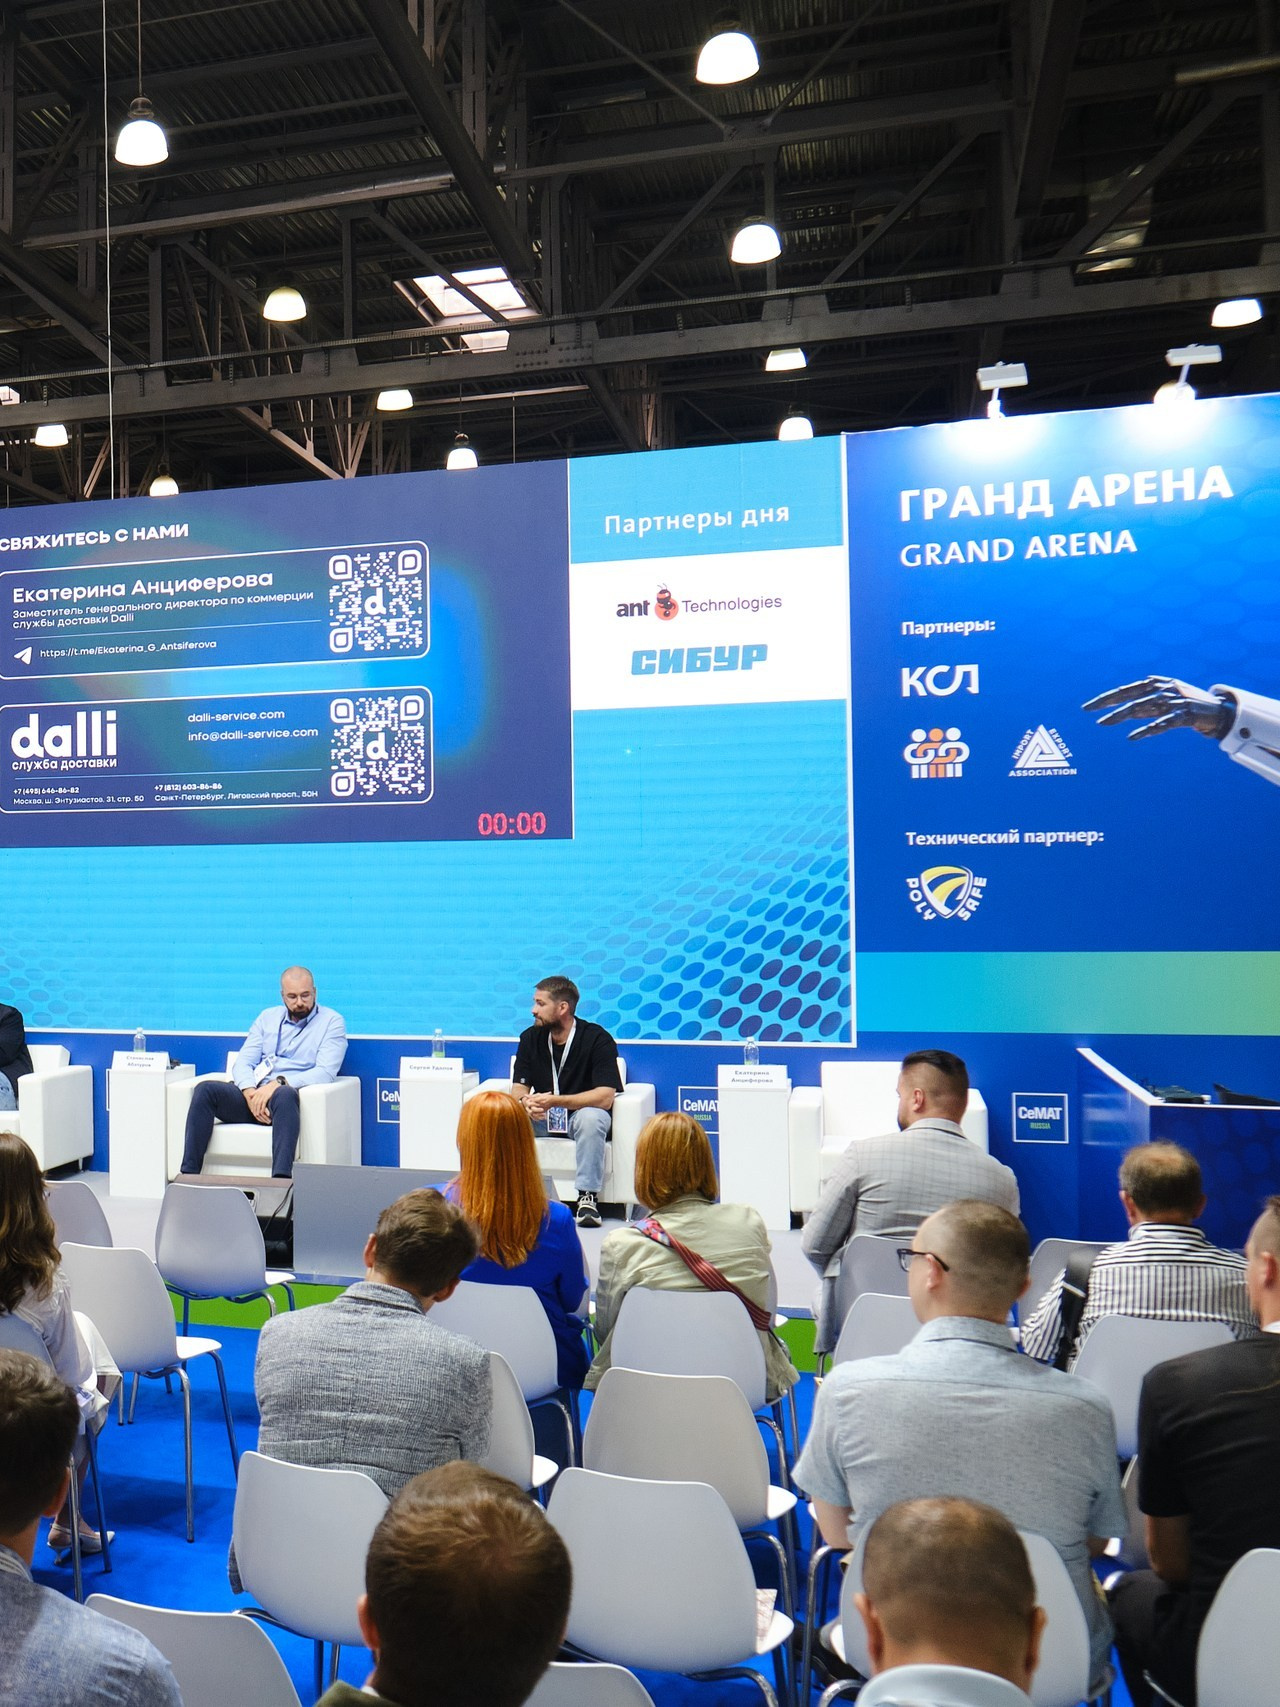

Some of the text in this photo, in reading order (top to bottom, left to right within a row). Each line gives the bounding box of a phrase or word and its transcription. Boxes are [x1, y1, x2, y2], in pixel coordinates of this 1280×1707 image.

[900, 465, 1234, 522] ГРАНД АРЕНА
[605, 506, 789, 538] Партнеры дня
[115, 529, 128, 543] С
[133, 523, 189, 541] НАМИ
[900, 529, 1138, 567] GRAND ARENA
[13, 572, 273, 604] Екатерина Анциферова
[13, 591, 314, 619] Заместитель генерального директора по коммерции
[616, 596, 782, 617] ant Technologies
[13, 613, 134, 631] службы доставки Dalli
[901, 620, 996, 638] Партнеры:
[40, 640, 217, 658] https://t.me/Ekaterina_G_Antsiferova
[631, 644, 769, 676] СИБУР
[188, 709, 285, 722] dalli-service.com
[11, 710, 117, 759] dalli
[188, 727, 319, 742] info@dalli-service.com
[1012, 728, 1073, 760] IMPORT EXPORT
[12, 757, 117, 772] служба доставки
[1008, 768, 1077, 777] ASSOCIATION
[478, 812, 546, 835] 00:00
[906, 829, 1104, 847] Технический партнер:
[906, 877, 987, 921] POLY SAFE
[1017, 1106, 1062, 1120] CeMAT
